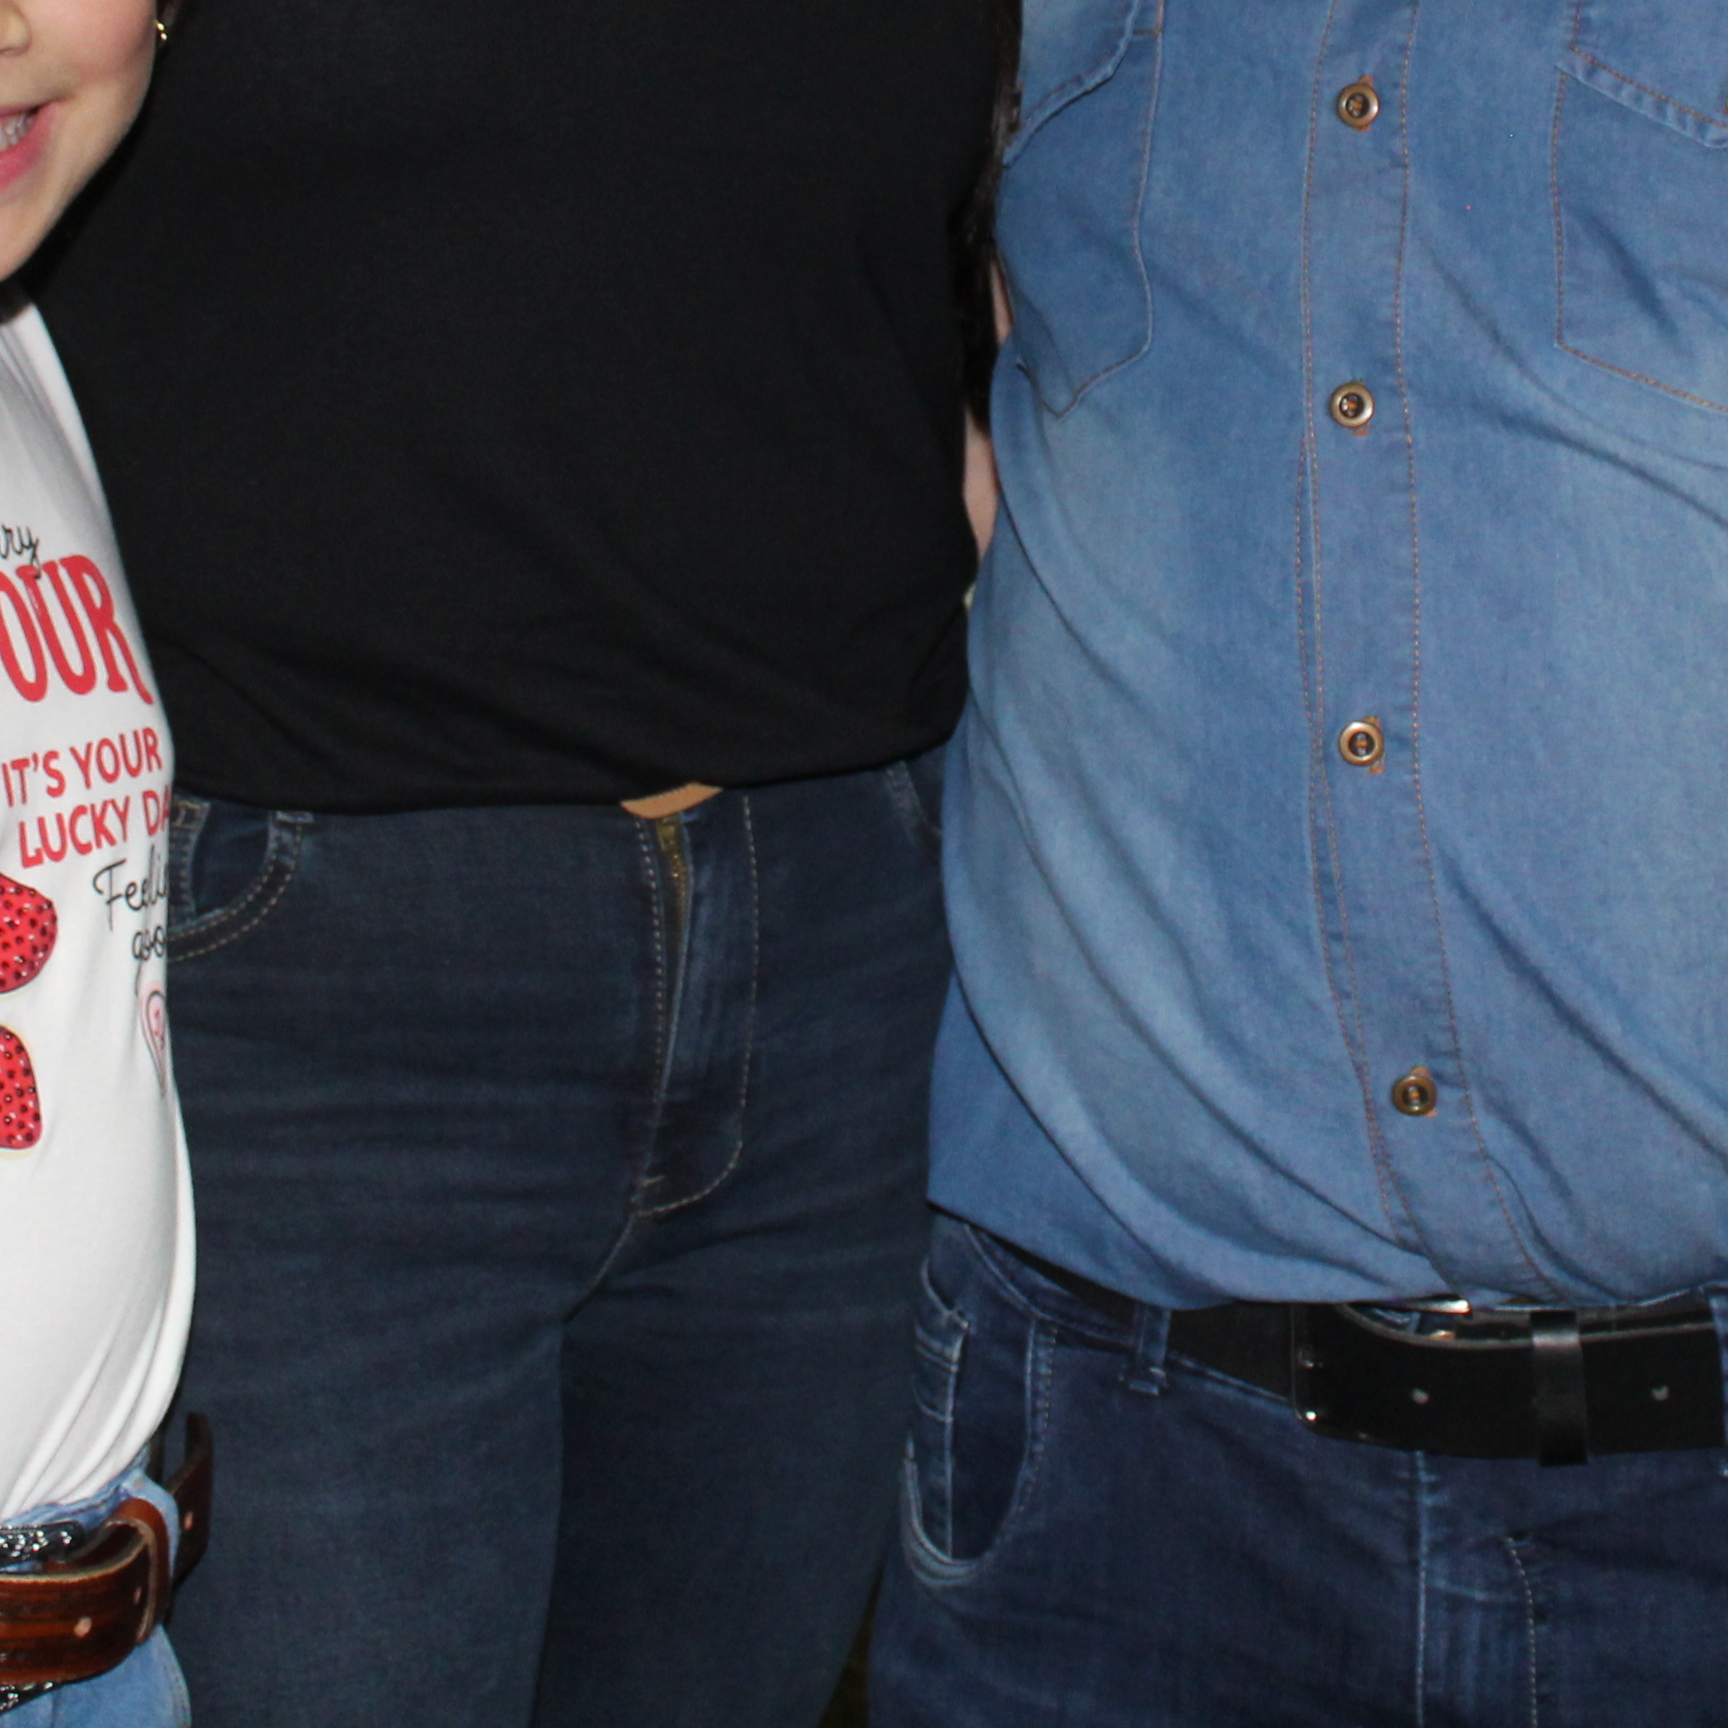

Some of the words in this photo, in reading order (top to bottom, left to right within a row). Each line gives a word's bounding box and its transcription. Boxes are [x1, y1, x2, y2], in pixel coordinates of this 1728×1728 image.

[2, 749, 67, 808] IT'S
[69, 727, 162, 789] YOUR
[18, 795, 131, 869] LUCKY
